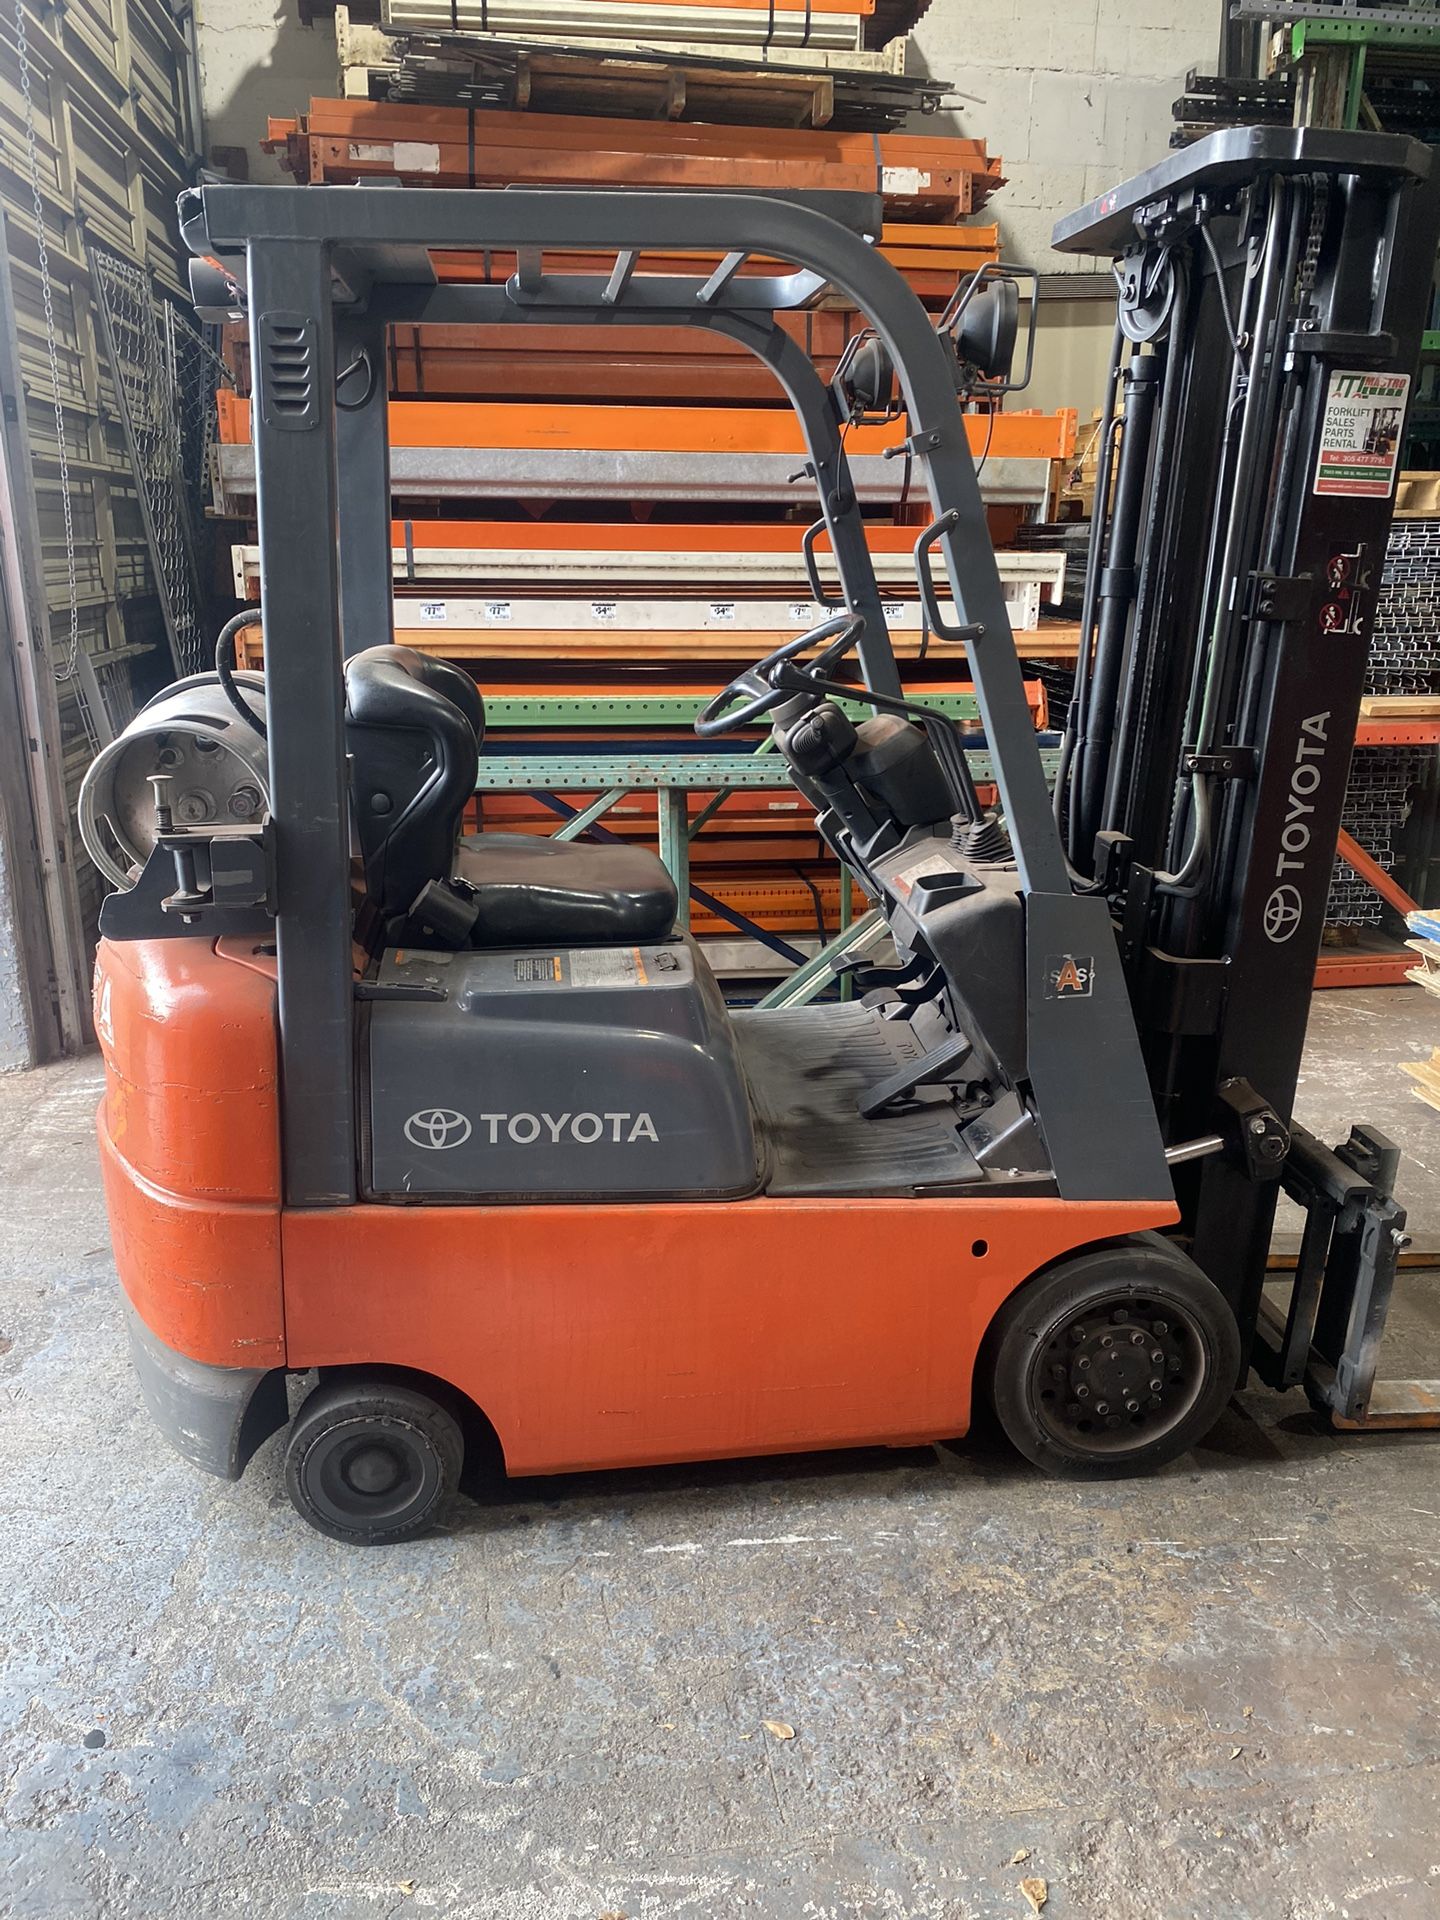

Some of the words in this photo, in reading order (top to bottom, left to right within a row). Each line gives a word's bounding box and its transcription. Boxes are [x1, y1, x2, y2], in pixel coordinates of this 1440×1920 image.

[1328, 407, 1371, 417] FORKLIFT
[1326, 417, 1355, 427] SALES
[1324, 428, 1354, 438] PARTS
[1323, 438, 1358, 448] RENTAL
[1276, 711, 1332, 877] TOYOTA
[480, 1112, 660, 1144] TOYOTA
